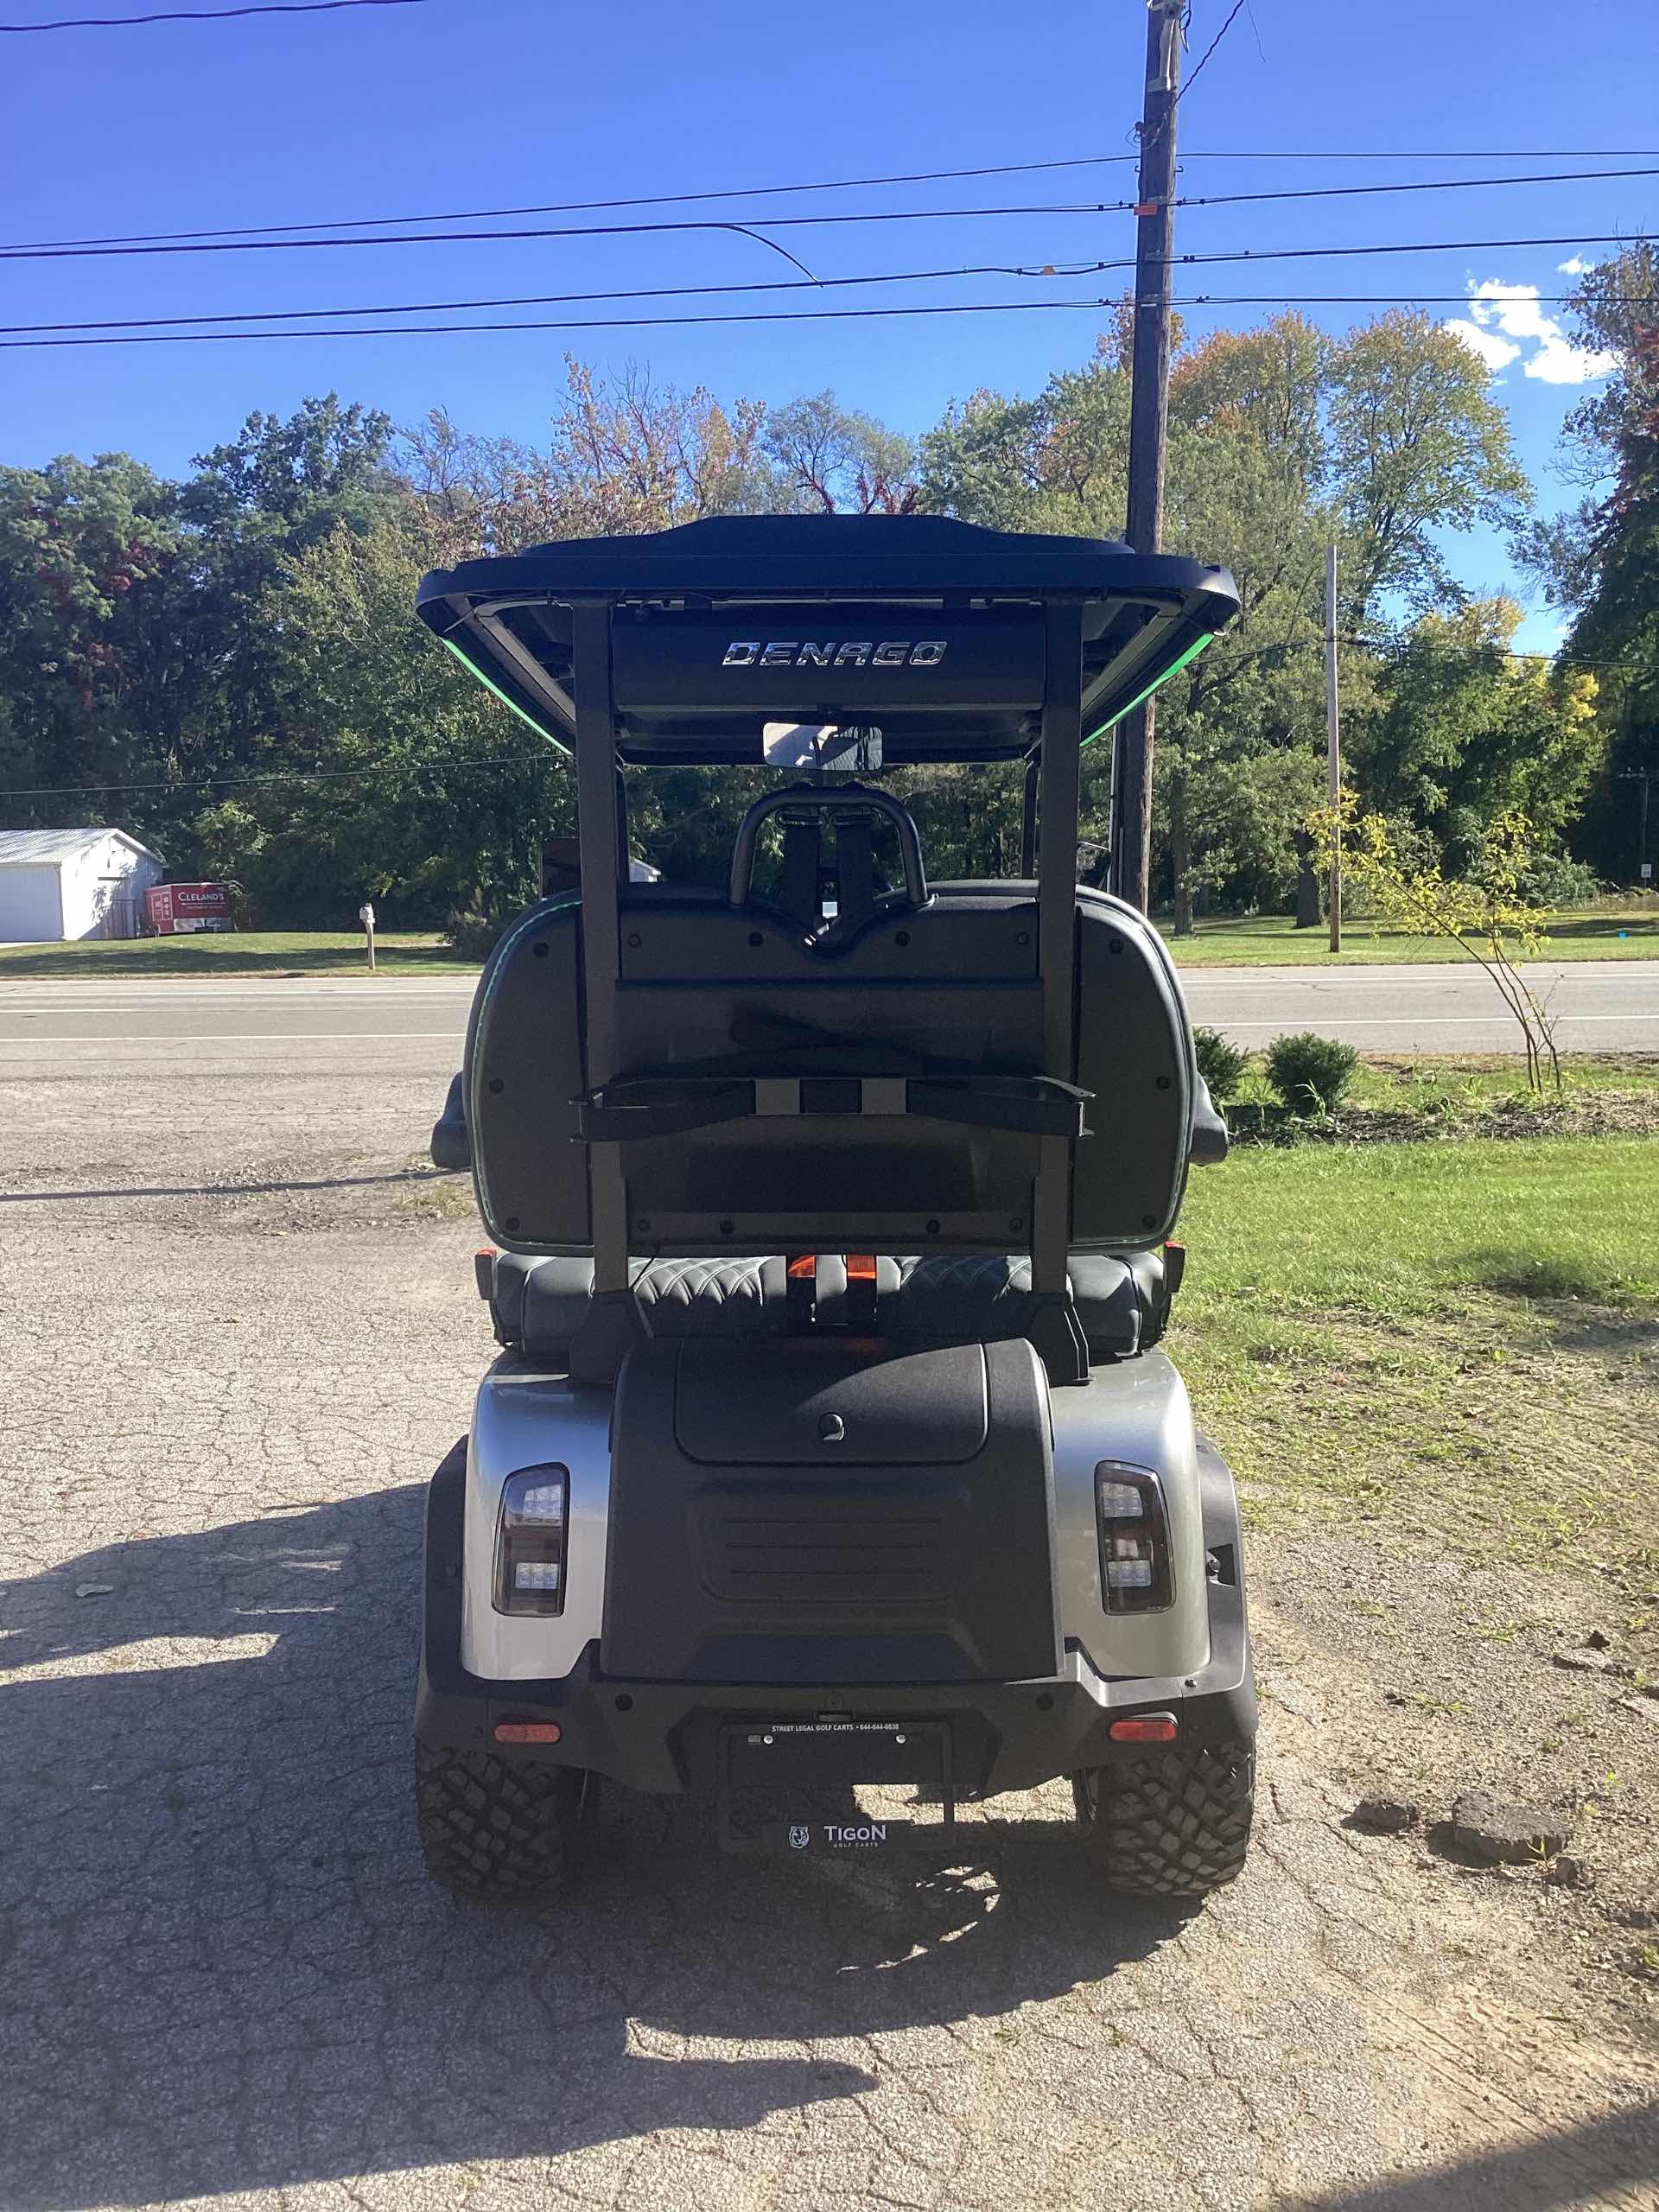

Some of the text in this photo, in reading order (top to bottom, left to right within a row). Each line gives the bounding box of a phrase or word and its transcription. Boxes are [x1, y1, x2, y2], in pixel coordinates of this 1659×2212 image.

[721, 641, 947, 665] DENAGO
[178, 892, 224, 901] CLELAND'S
[823, 1824, 887, 1840] TIGON
